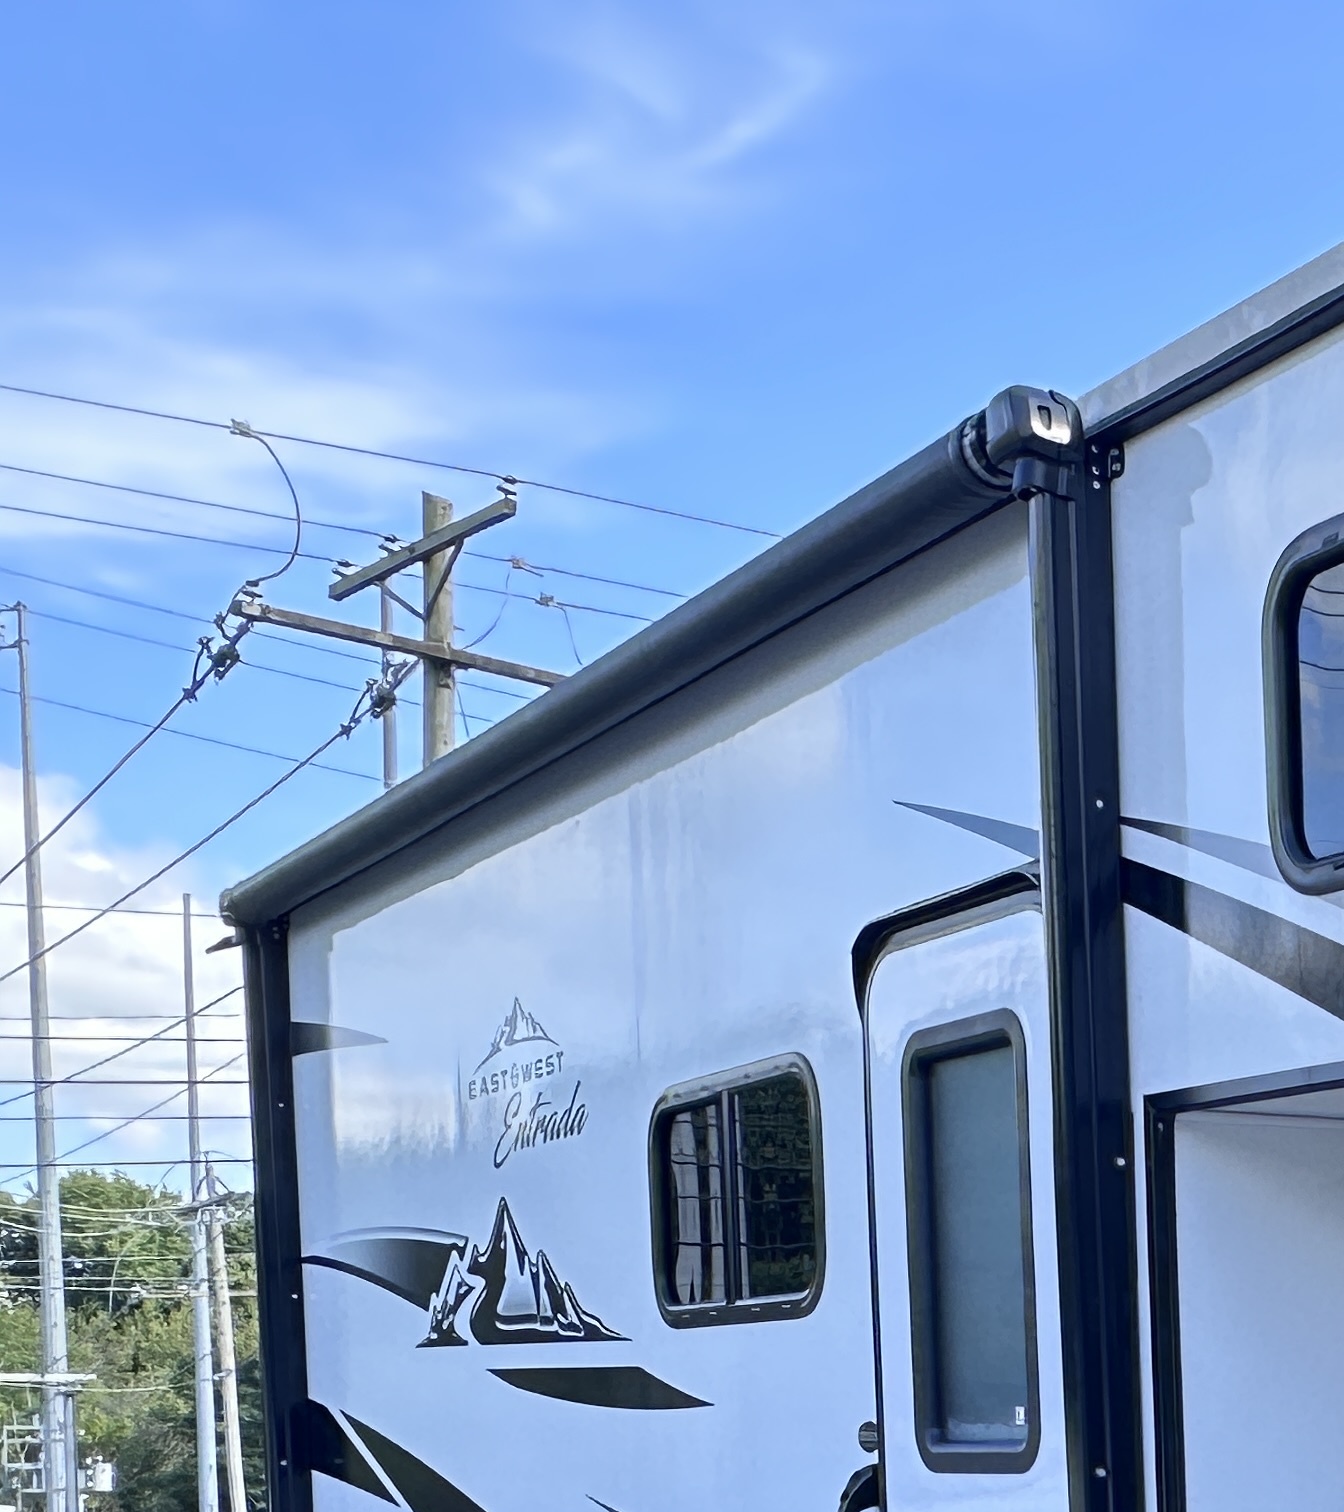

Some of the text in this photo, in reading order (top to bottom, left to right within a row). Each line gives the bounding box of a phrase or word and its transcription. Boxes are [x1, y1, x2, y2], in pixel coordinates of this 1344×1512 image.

[468, 1051, 564, 1100] EAST WEST
[494, 1080, 589, 1169] Entrada
